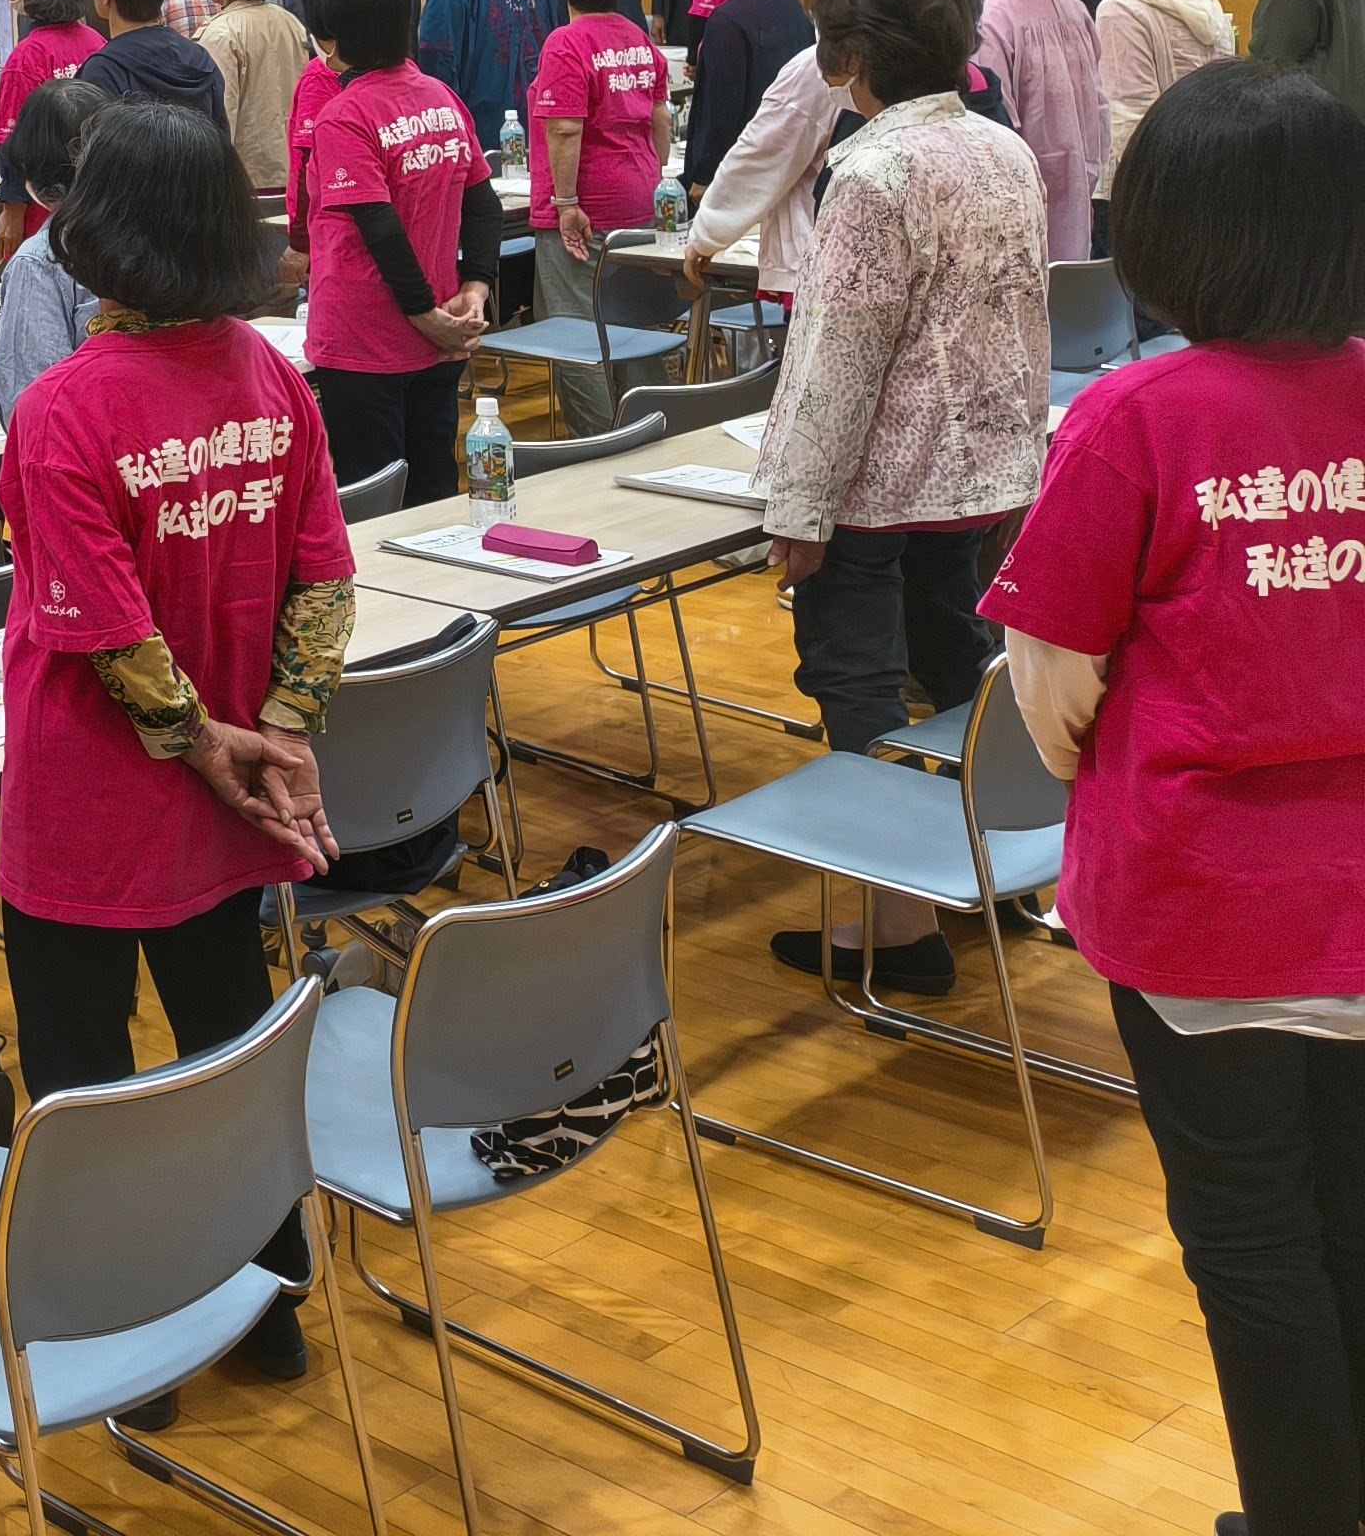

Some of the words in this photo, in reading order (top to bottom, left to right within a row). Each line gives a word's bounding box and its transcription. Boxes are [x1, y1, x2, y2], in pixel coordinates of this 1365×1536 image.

[115, 415, 294, 498] 私達の健康は
